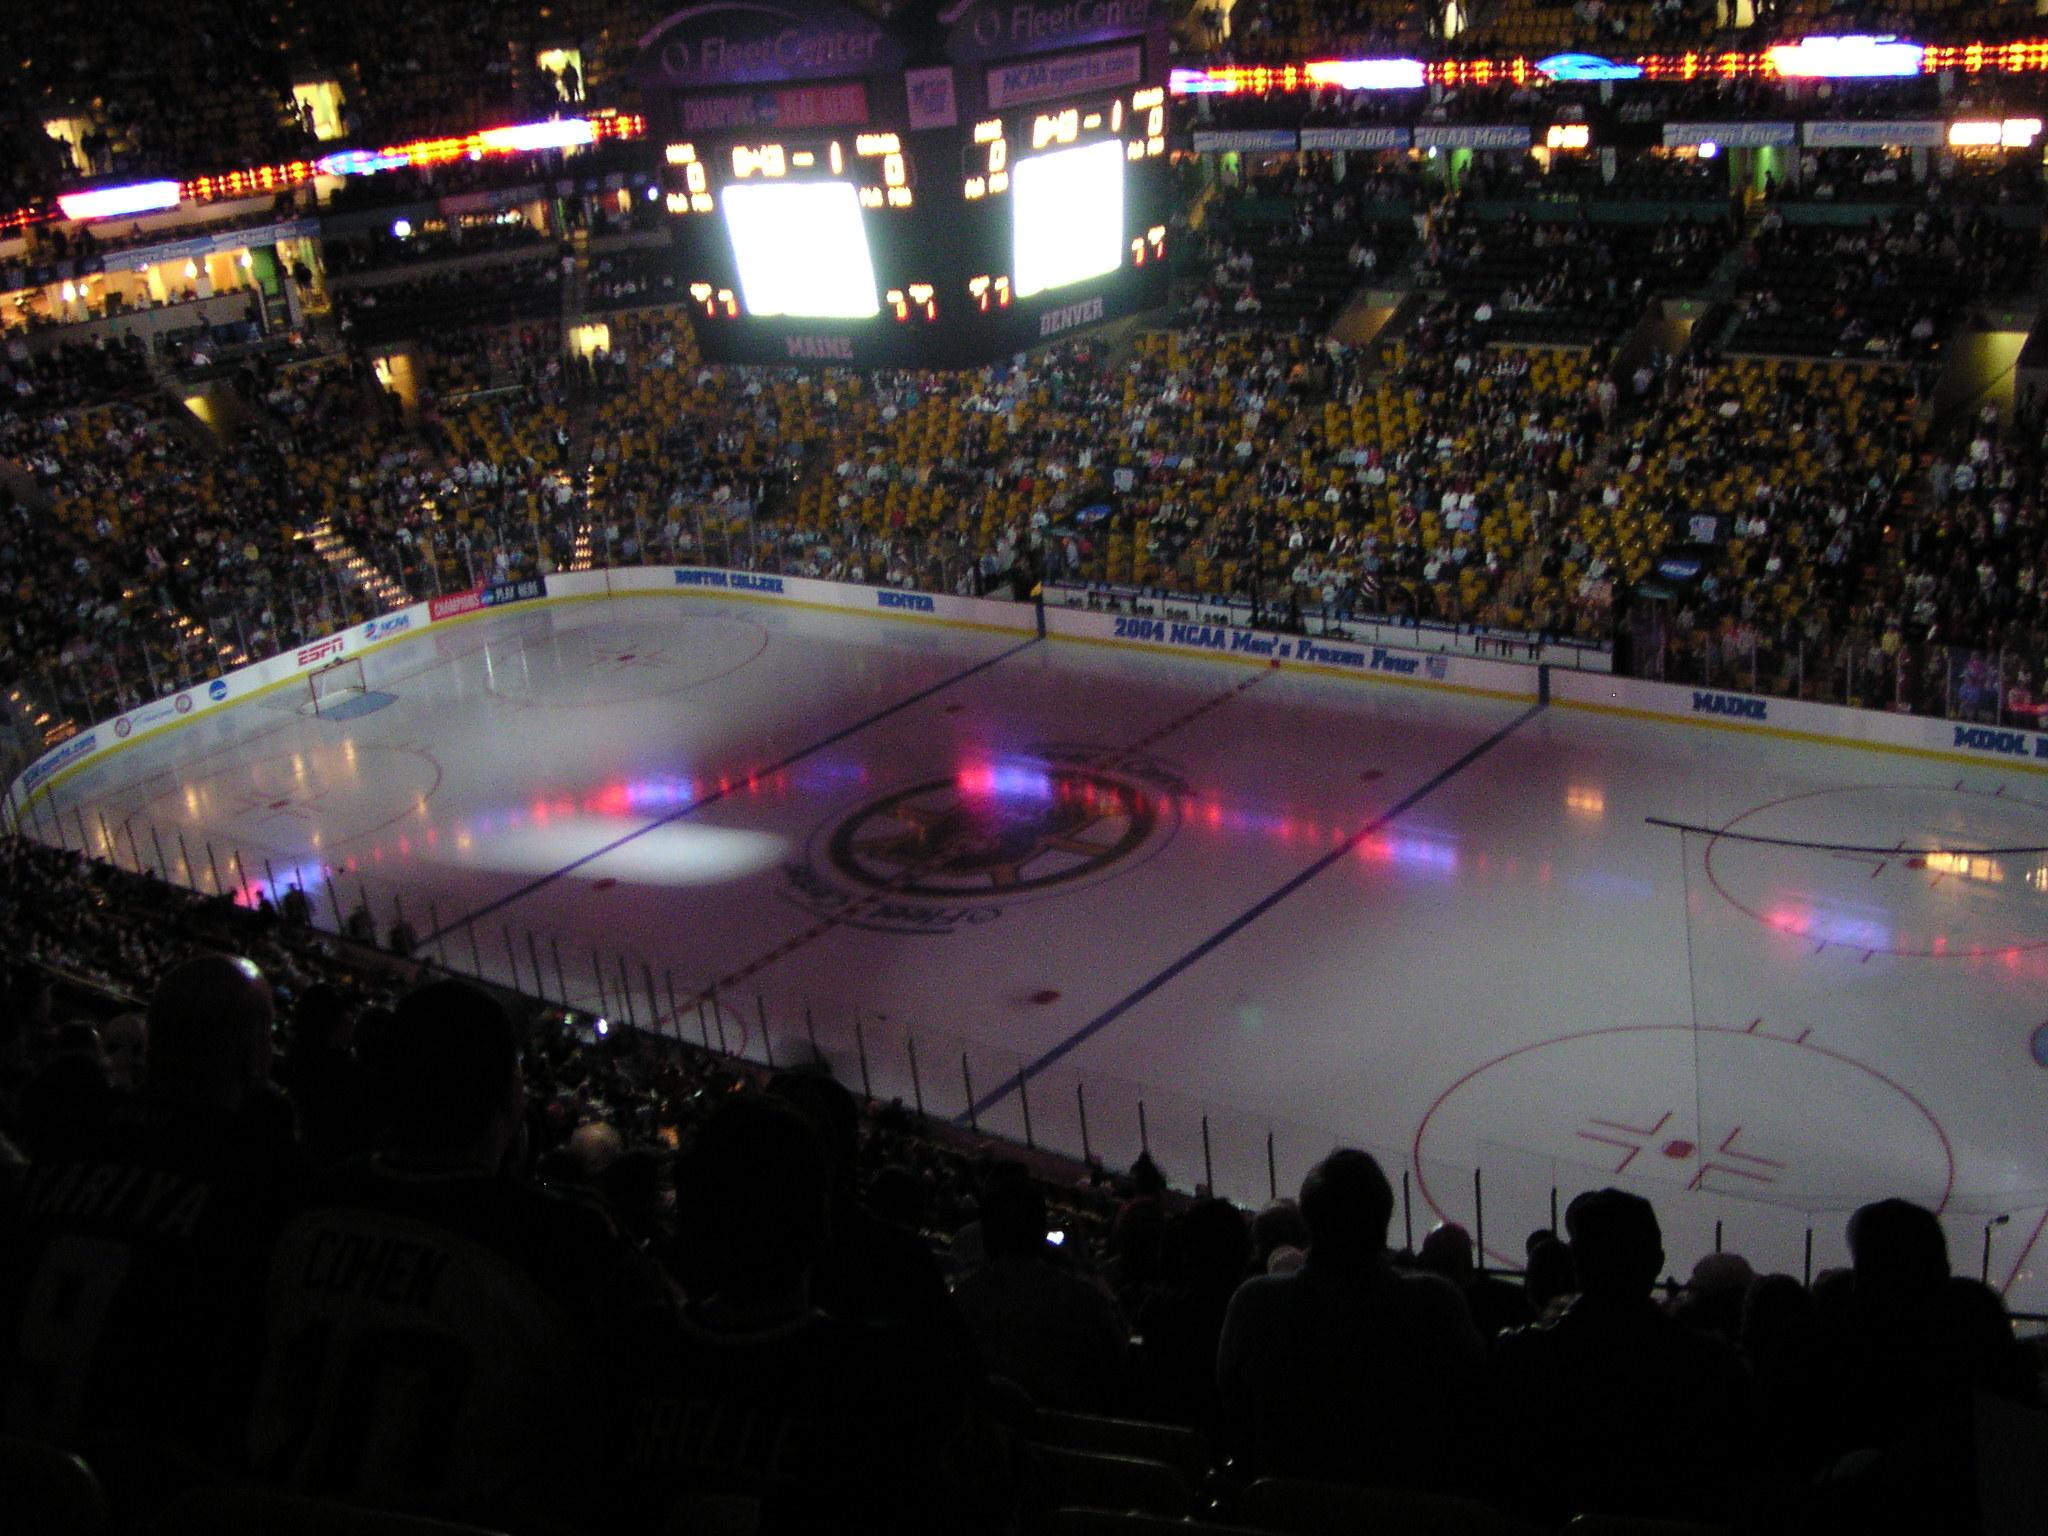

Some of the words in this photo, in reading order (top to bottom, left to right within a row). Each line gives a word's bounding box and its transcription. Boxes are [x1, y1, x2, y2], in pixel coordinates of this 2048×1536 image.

[1356, 129, 1395, 146] 2004
[1039, 299, 1103, 337] DENVER
[786, 335, 854, 361] MAINE
[298, 638, 344, 666] ESPN
[1113, 617, 1165, 642] 2004
[1169, 623, 1226, 650] NCAA
[1232, 631, 1292, 658] Men's
[1299, 638, 1364, 668] Frozen
[1370, 648, 1419, 675] Four
[1692, 691, 1768, 721] MAINE
